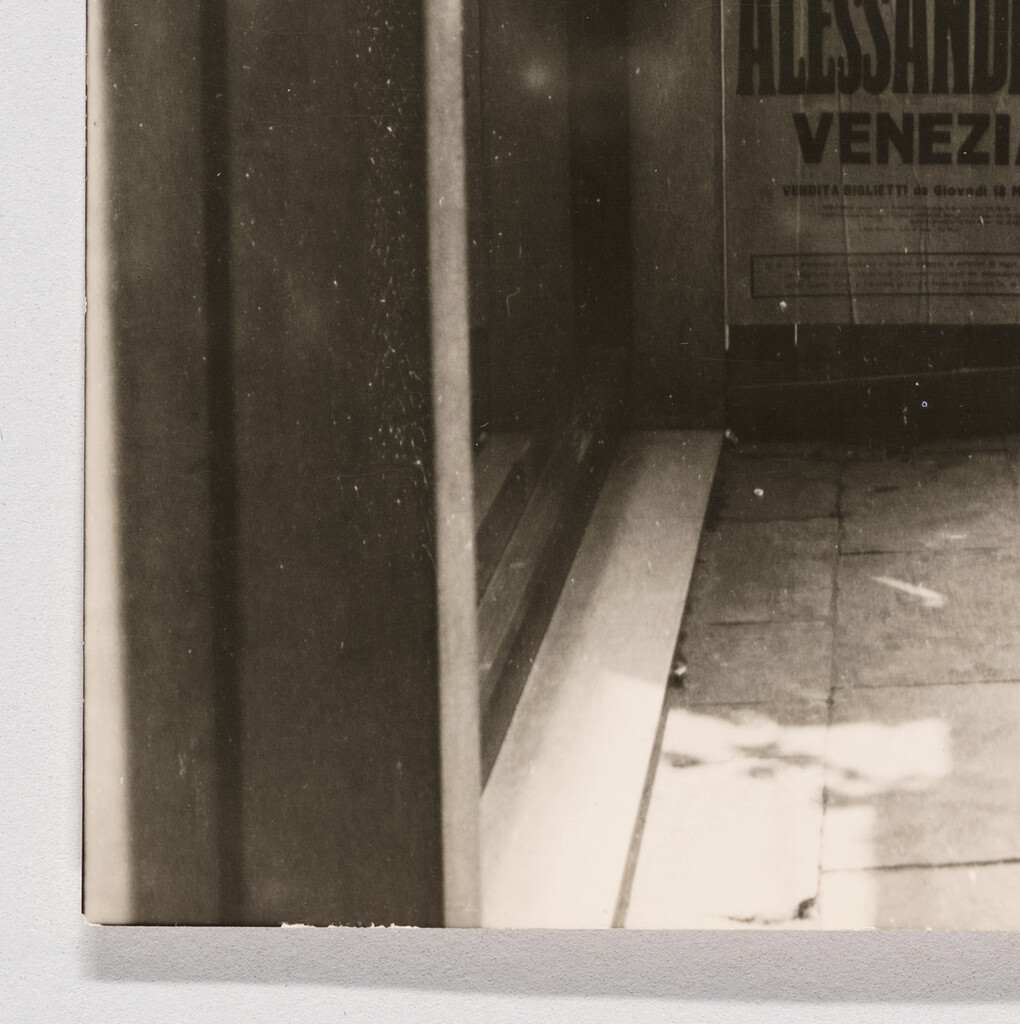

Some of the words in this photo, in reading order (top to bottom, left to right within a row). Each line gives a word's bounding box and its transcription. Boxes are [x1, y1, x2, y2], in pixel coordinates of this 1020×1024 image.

[782, 184, 840, 197] VENDITA
[843, 184, 908, 196] BIGLIETTI
[913, 185, 928, 196] da
